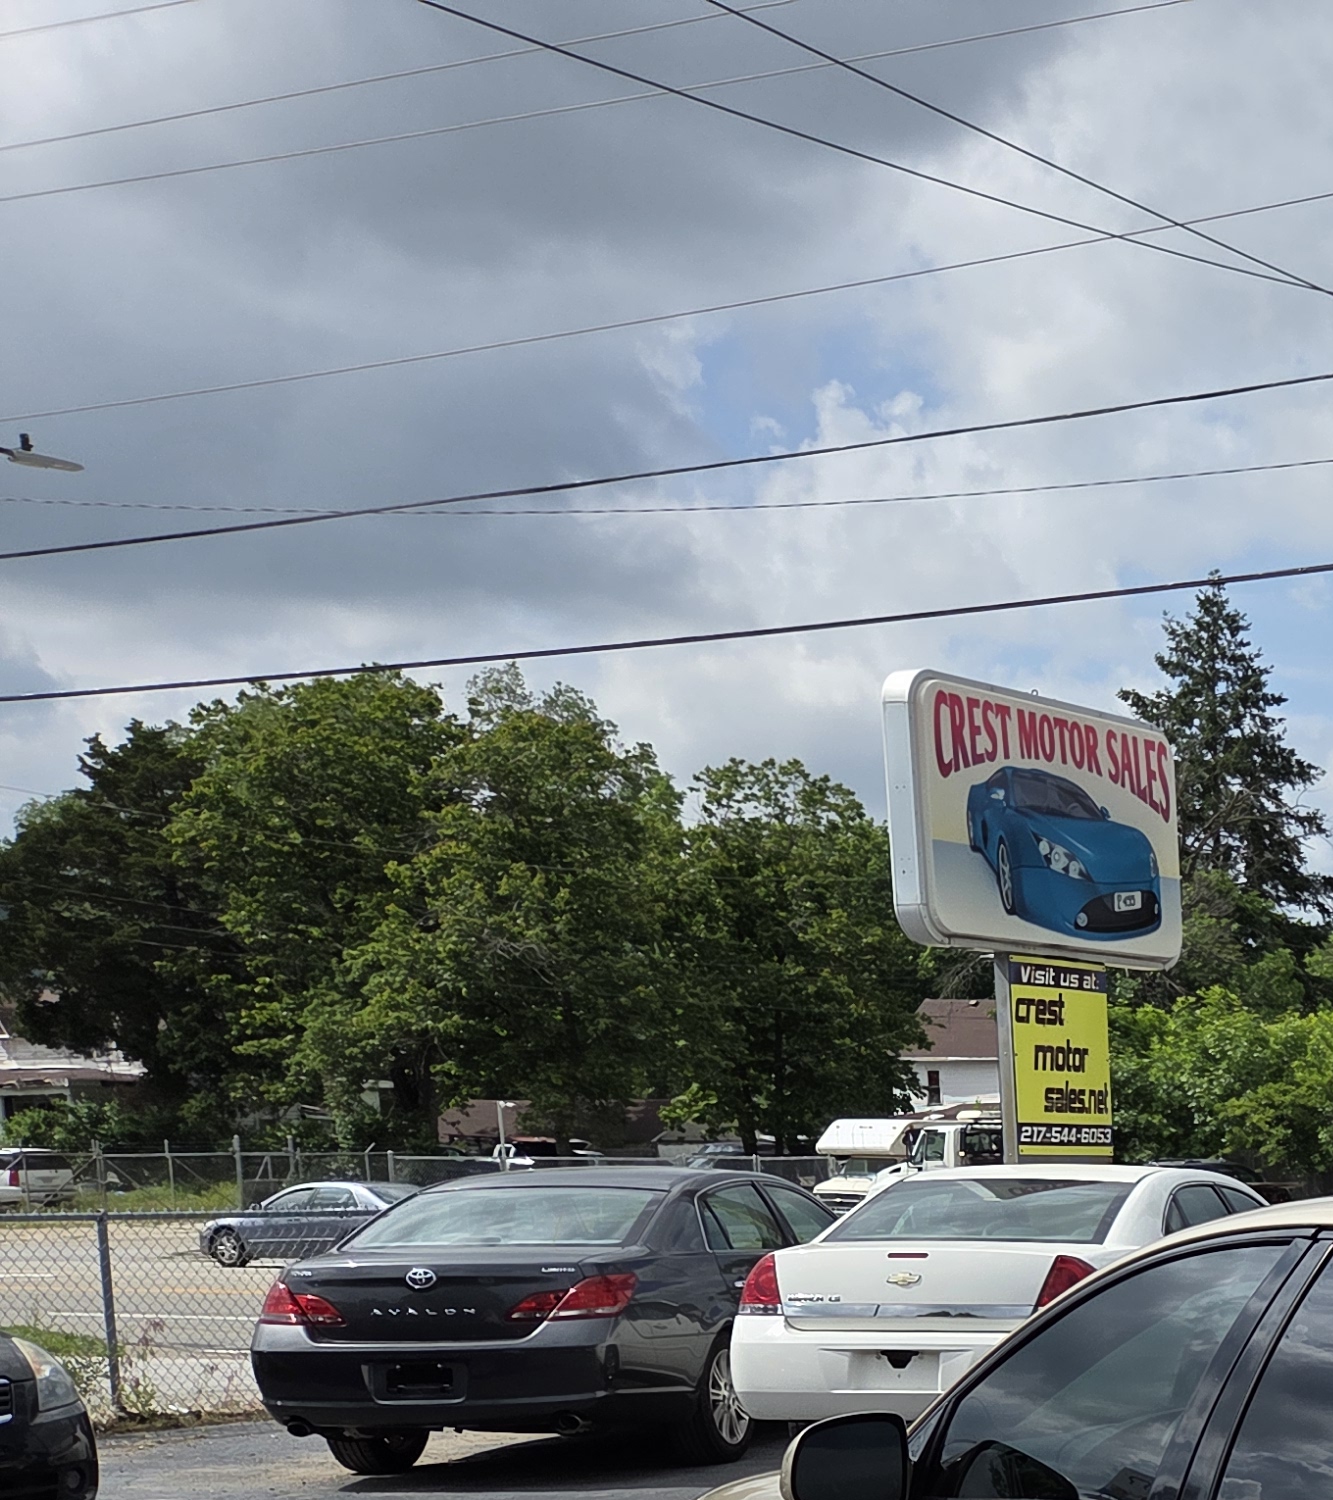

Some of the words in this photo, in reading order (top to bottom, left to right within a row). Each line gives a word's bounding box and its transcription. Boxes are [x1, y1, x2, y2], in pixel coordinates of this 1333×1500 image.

[933, 689, 1011, 778] CREST
[1017, 708, 1103, 777] MOTOR
[1106, 729, 1171, 824] SALES
[1020, 965, 1055, 986] Visit
[1060, 972, 1079, 989] us
[1083, 974, 1100, 990] at:
[1015, 993, 1065, 1026] crest
[1034, 1039, 1089, 1073] motor
[1044, 1080, 1109, 1115] sales.net
[1020, 1126, 1112, 1143] 217-544-6053
[370, 1307, 476, 1316] AVALON
